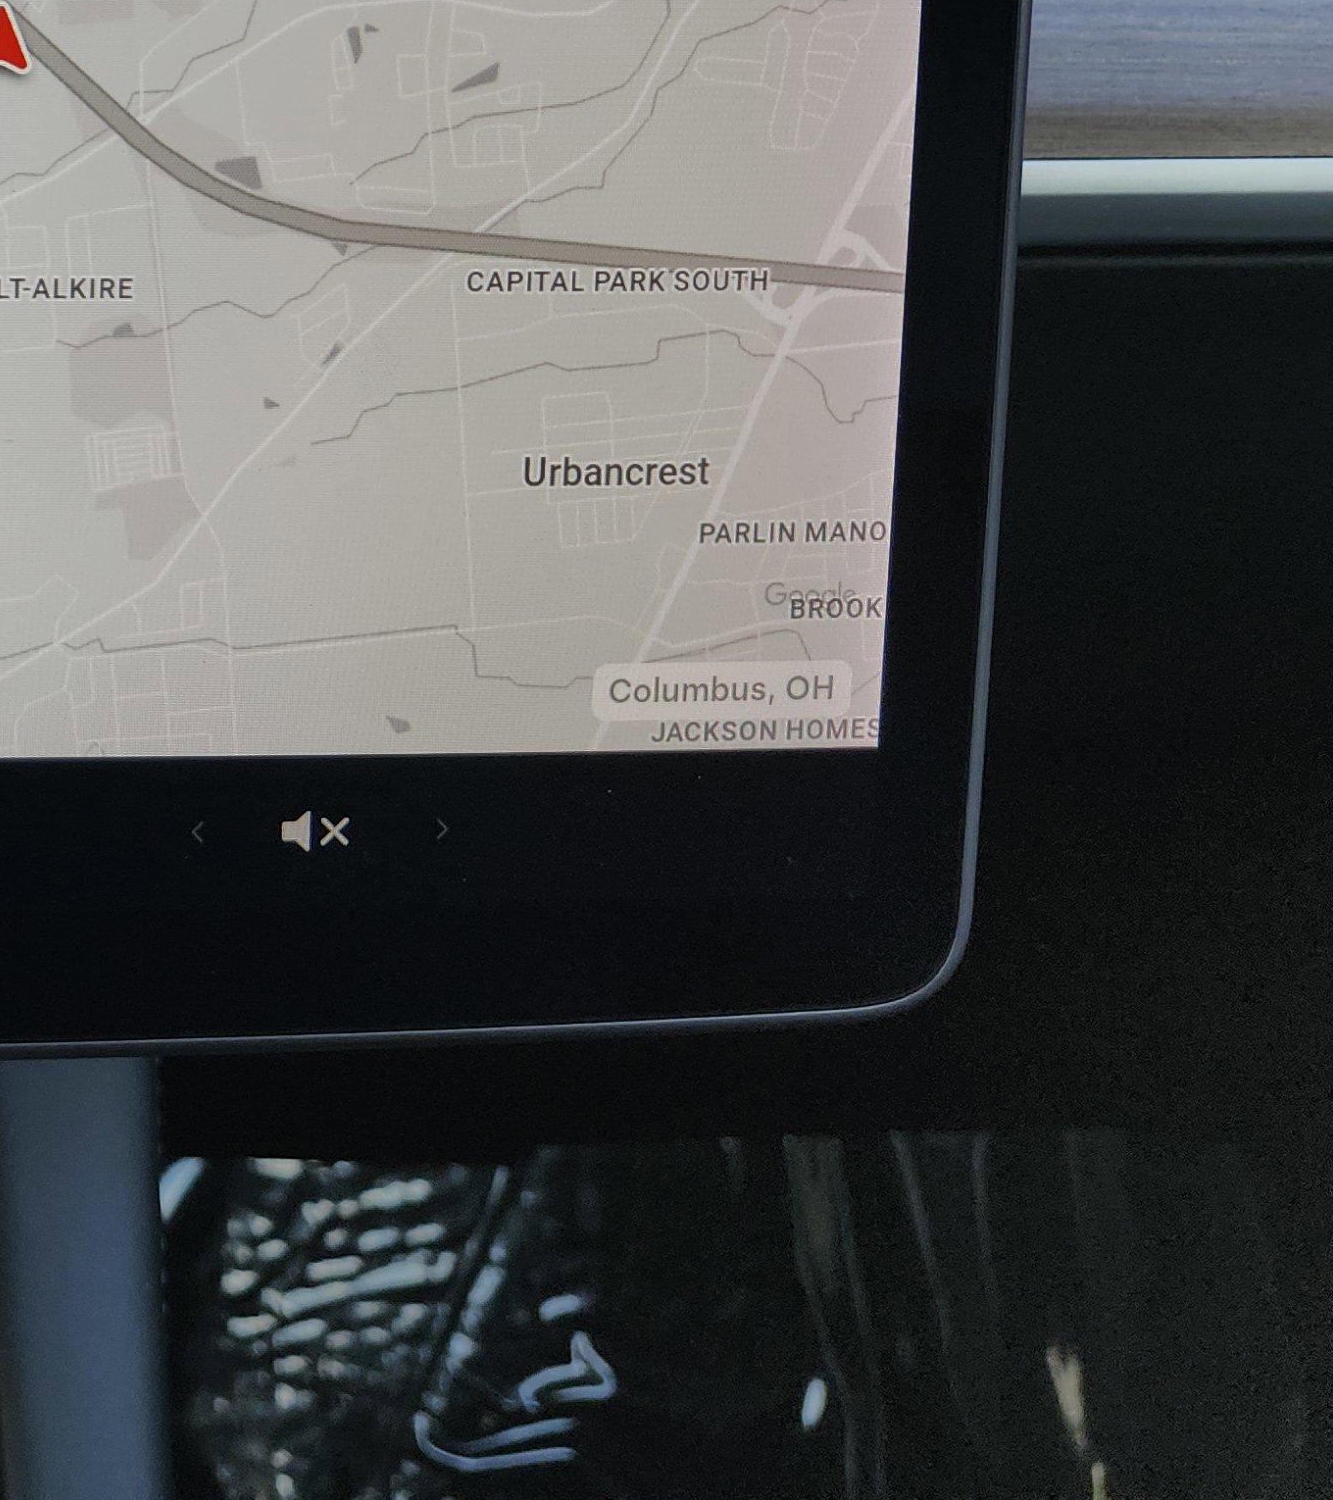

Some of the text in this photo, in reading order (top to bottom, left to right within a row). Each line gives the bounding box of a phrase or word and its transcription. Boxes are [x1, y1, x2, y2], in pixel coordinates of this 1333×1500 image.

[467, 269, 769, 293] CAPITAL PARK SOUTH
[524, 456, 710, 487] Urbancrest
[699, 521, 886, 544] PARLIN MANO
[790, 598, 882, 619] BROOK
[609, 675, 833, 706] Columbus, OH
[651, 718, 879, 742] JACKSON HOMES
